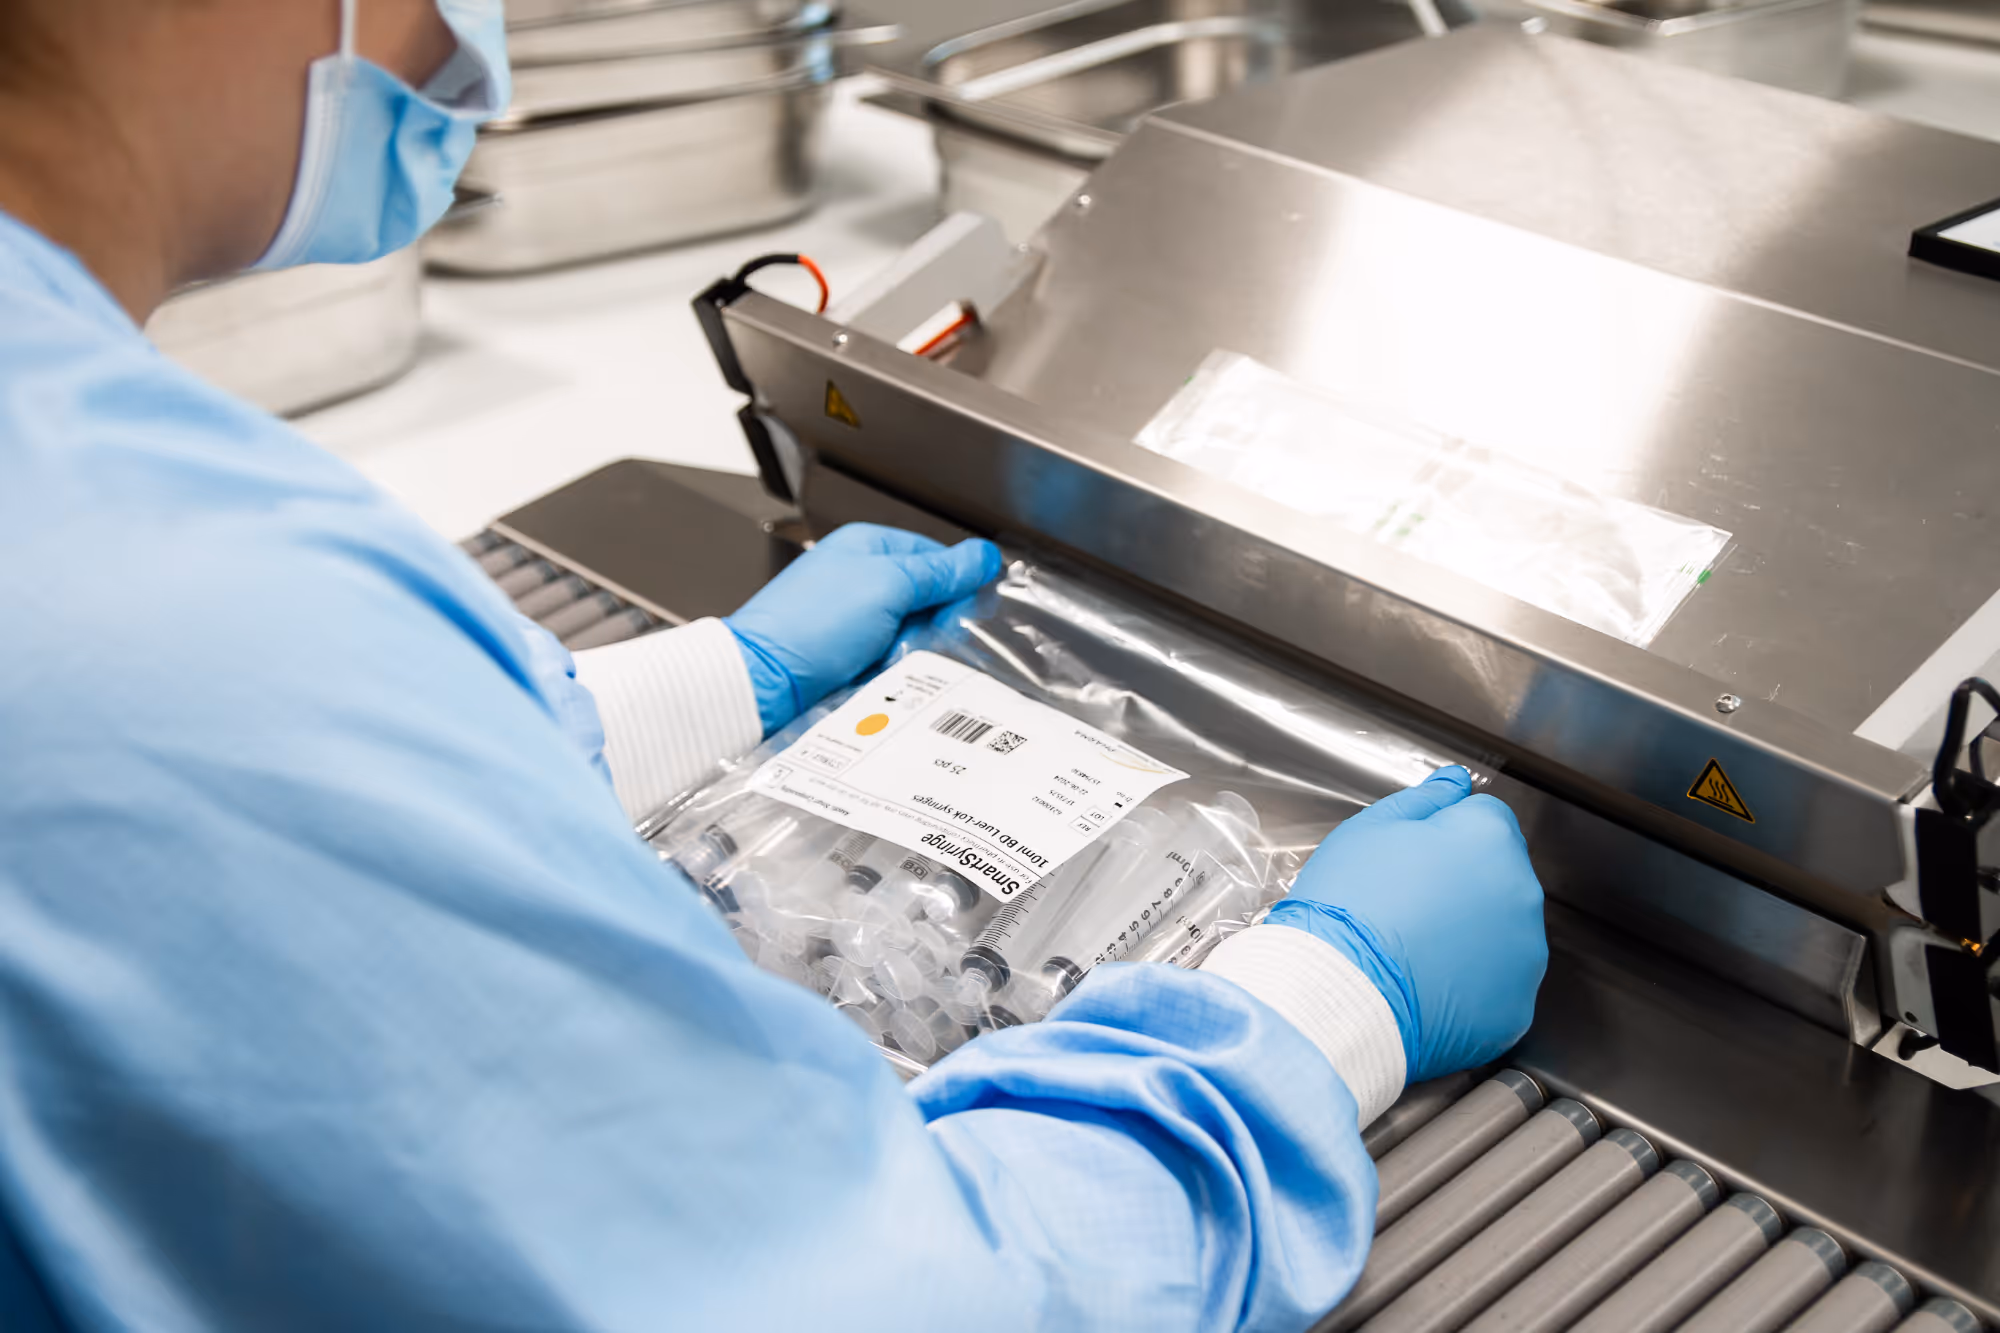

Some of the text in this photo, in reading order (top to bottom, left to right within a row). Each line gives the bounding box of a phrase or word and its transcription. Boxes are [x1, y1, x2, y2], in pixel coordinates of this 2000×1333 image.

[933, 759, 967, 775] 25 pcs
[1089, 812, 1106, 822] LOT
[912, 794, 1049, 868] 10ml BD Luer-Lok syringes
[1077, 823, 1092, 832] REF
[920, 833, 1020, 895] SmartSyringe
[1166, 851, 1194, 877] 10ml
[1174, 877, 1183, 887] 9
[1163, 888, 1173, 899] 8
[1151, 900, 1162, 910] 7
[1141, 909, 1151, 921] 6
[1128, 920, 1140, 932] 5
[1118, 931, 1127, 941] 4
[1106, 942, 1116, 954] 3
